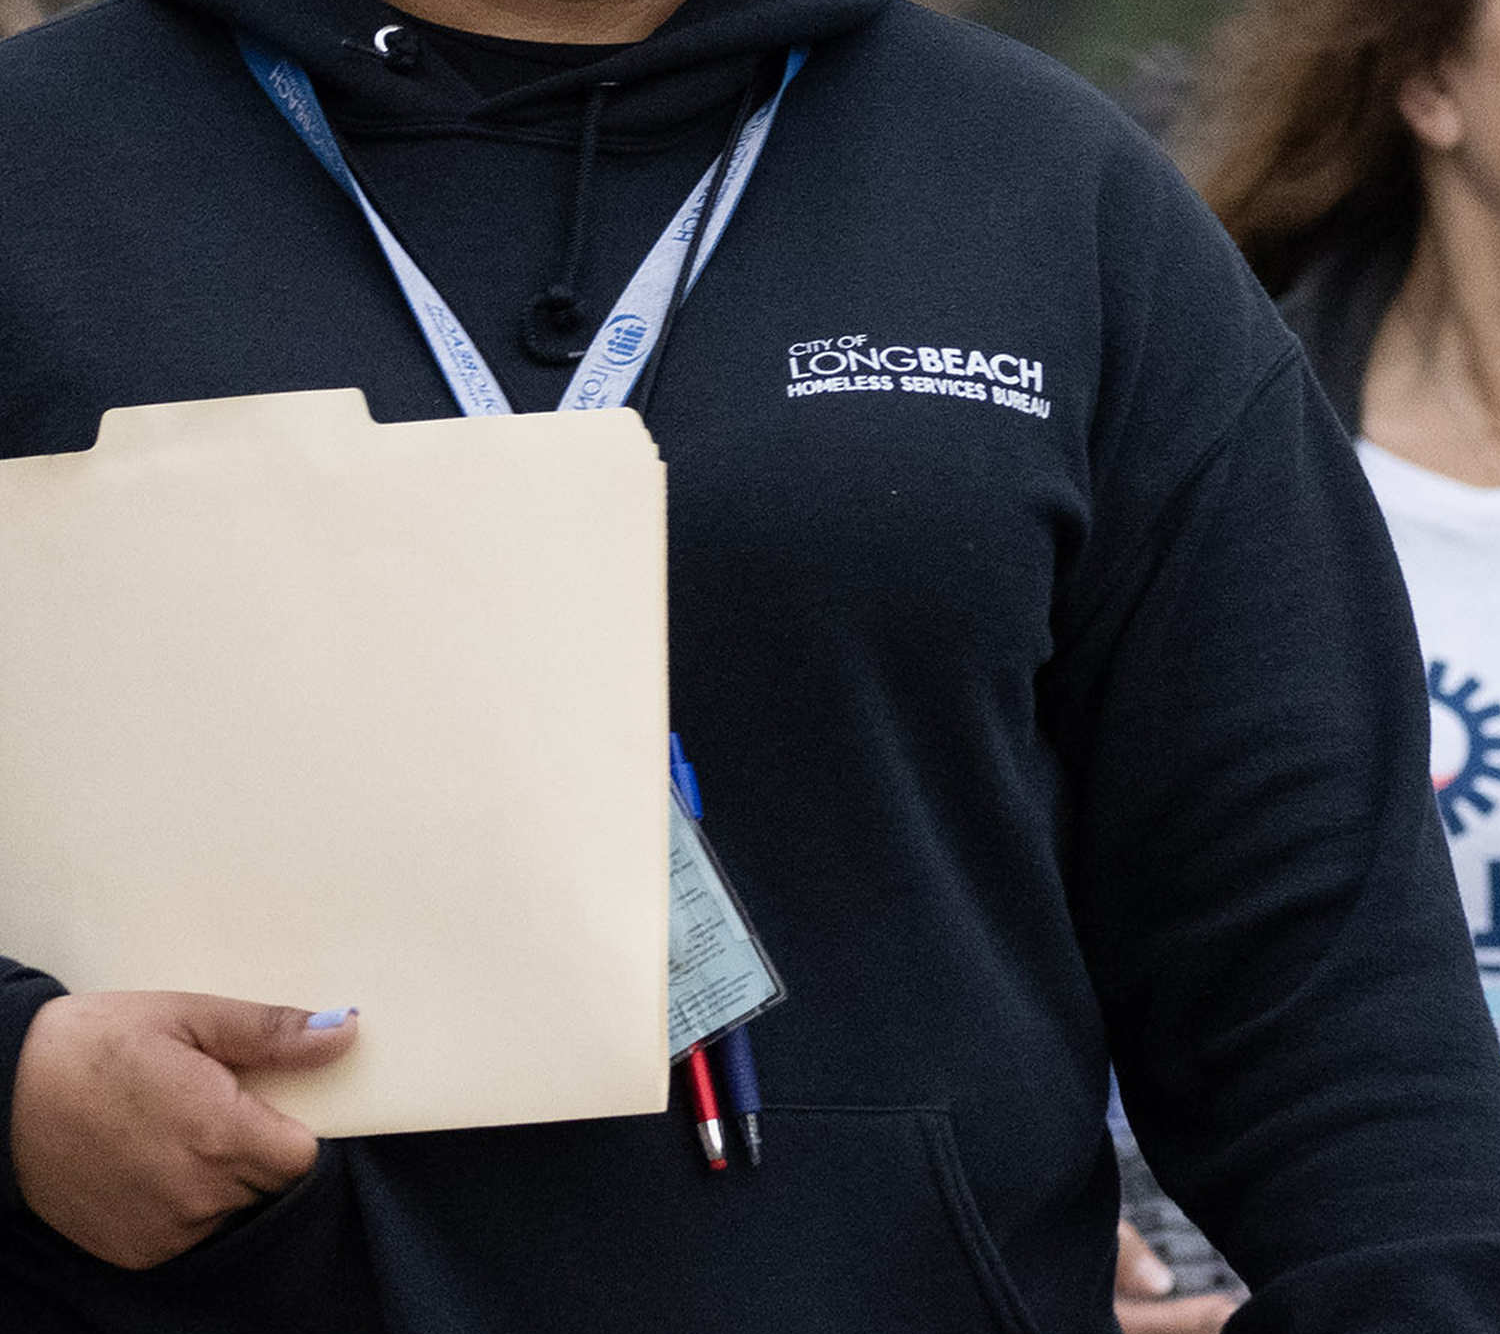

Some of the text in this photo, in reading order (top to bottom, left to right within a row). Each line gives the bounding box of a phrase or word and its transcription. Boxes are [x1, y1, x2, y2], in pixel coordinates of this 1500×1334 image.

[788, 334, 867, 356] CITY OF
[787, 375, 1050, 419] HOMELESS SERVICES BUREAU
